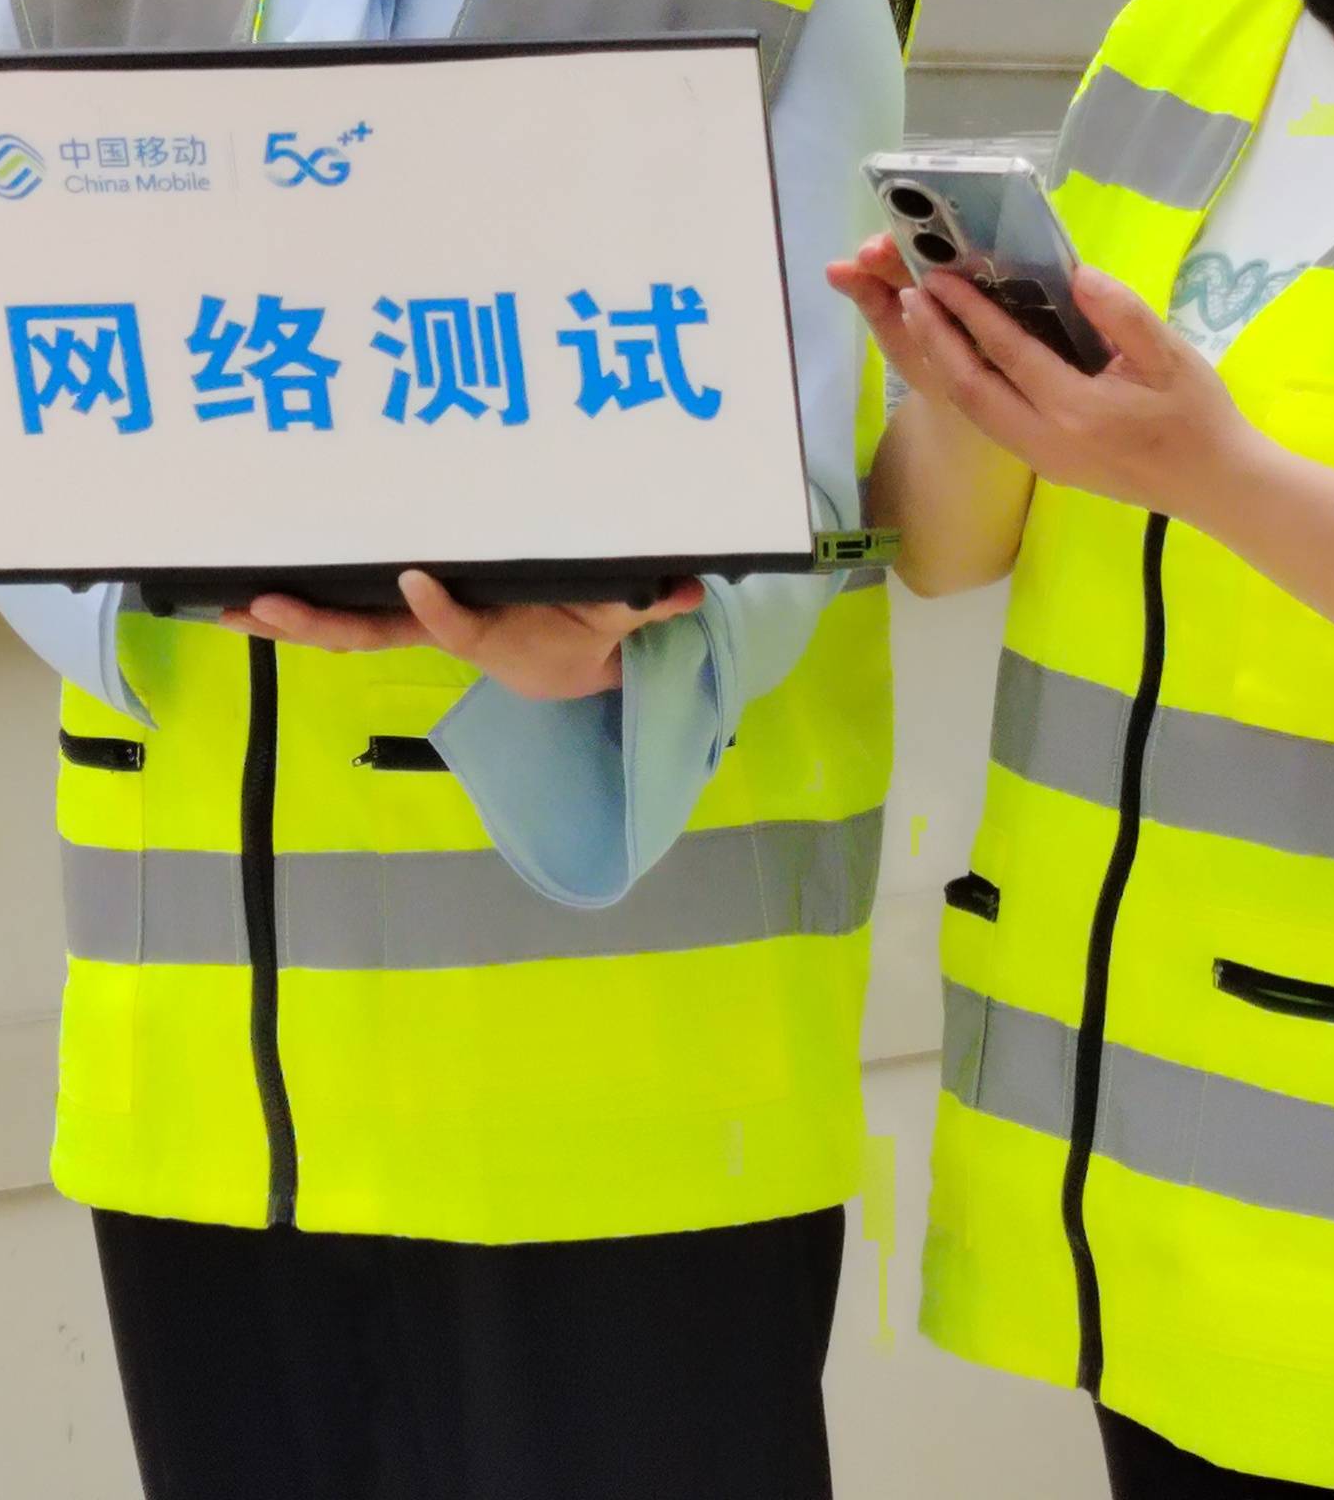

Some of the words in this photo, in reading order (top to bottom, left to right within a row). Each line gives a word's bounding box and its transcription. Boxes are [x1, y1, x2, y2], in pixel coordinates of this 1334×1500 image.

[59, 134, 207, 169] 中国移动
[64, 174, 130, 194] China
[136, 174, 210, 192] Mobile
[4, 283, 722, 436] 网络测试
